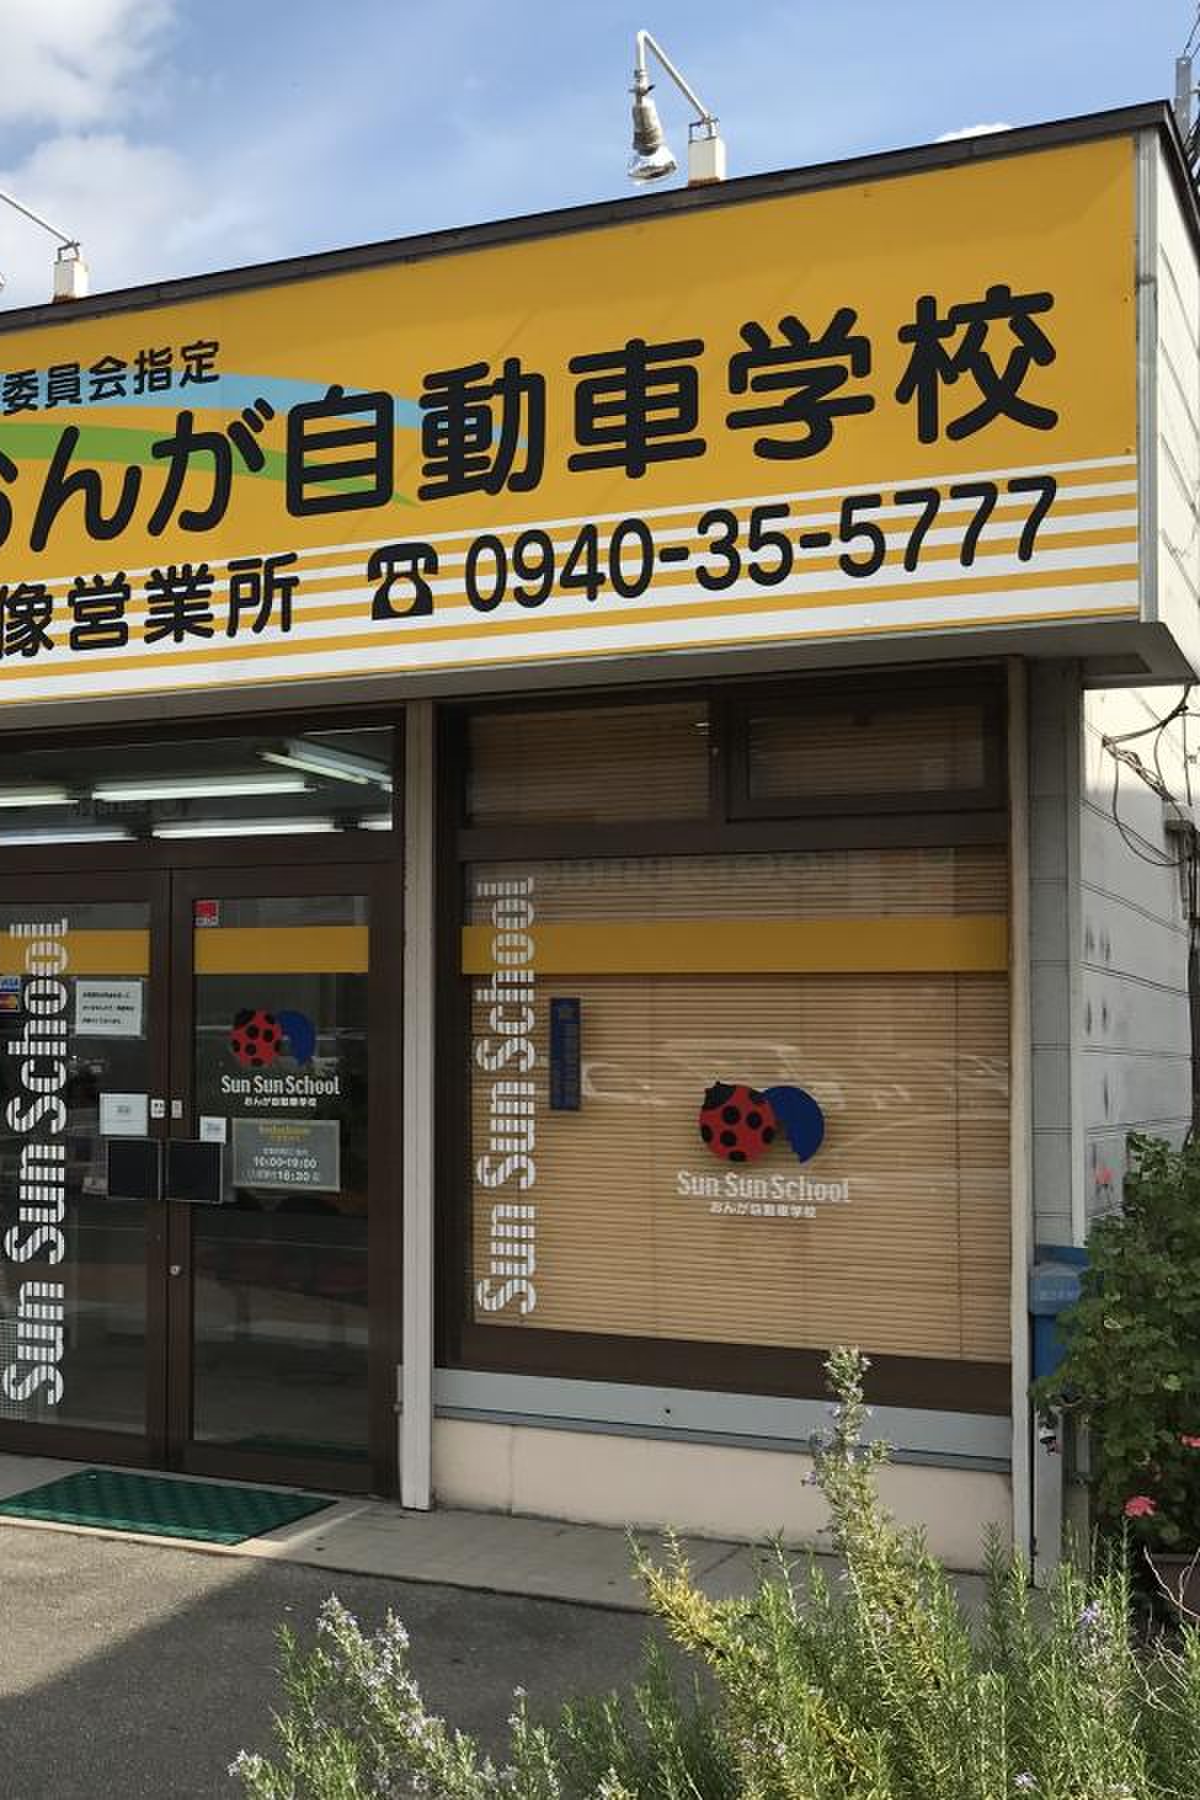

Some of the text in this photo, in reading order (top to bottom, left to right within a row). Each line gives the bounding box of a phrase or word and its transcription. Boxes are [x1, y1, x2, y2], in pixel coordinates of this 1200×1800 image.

[465, 475, 1059, 613] 0940-35-5777
[221, 1074, 340, 1095] Sun Sun School
[476, 876, 536, 1314] Sun Sun School
[3, 918, 68, 1406] Sun Sun School
[677, 1170, 851, 1203] Sun Sun School
